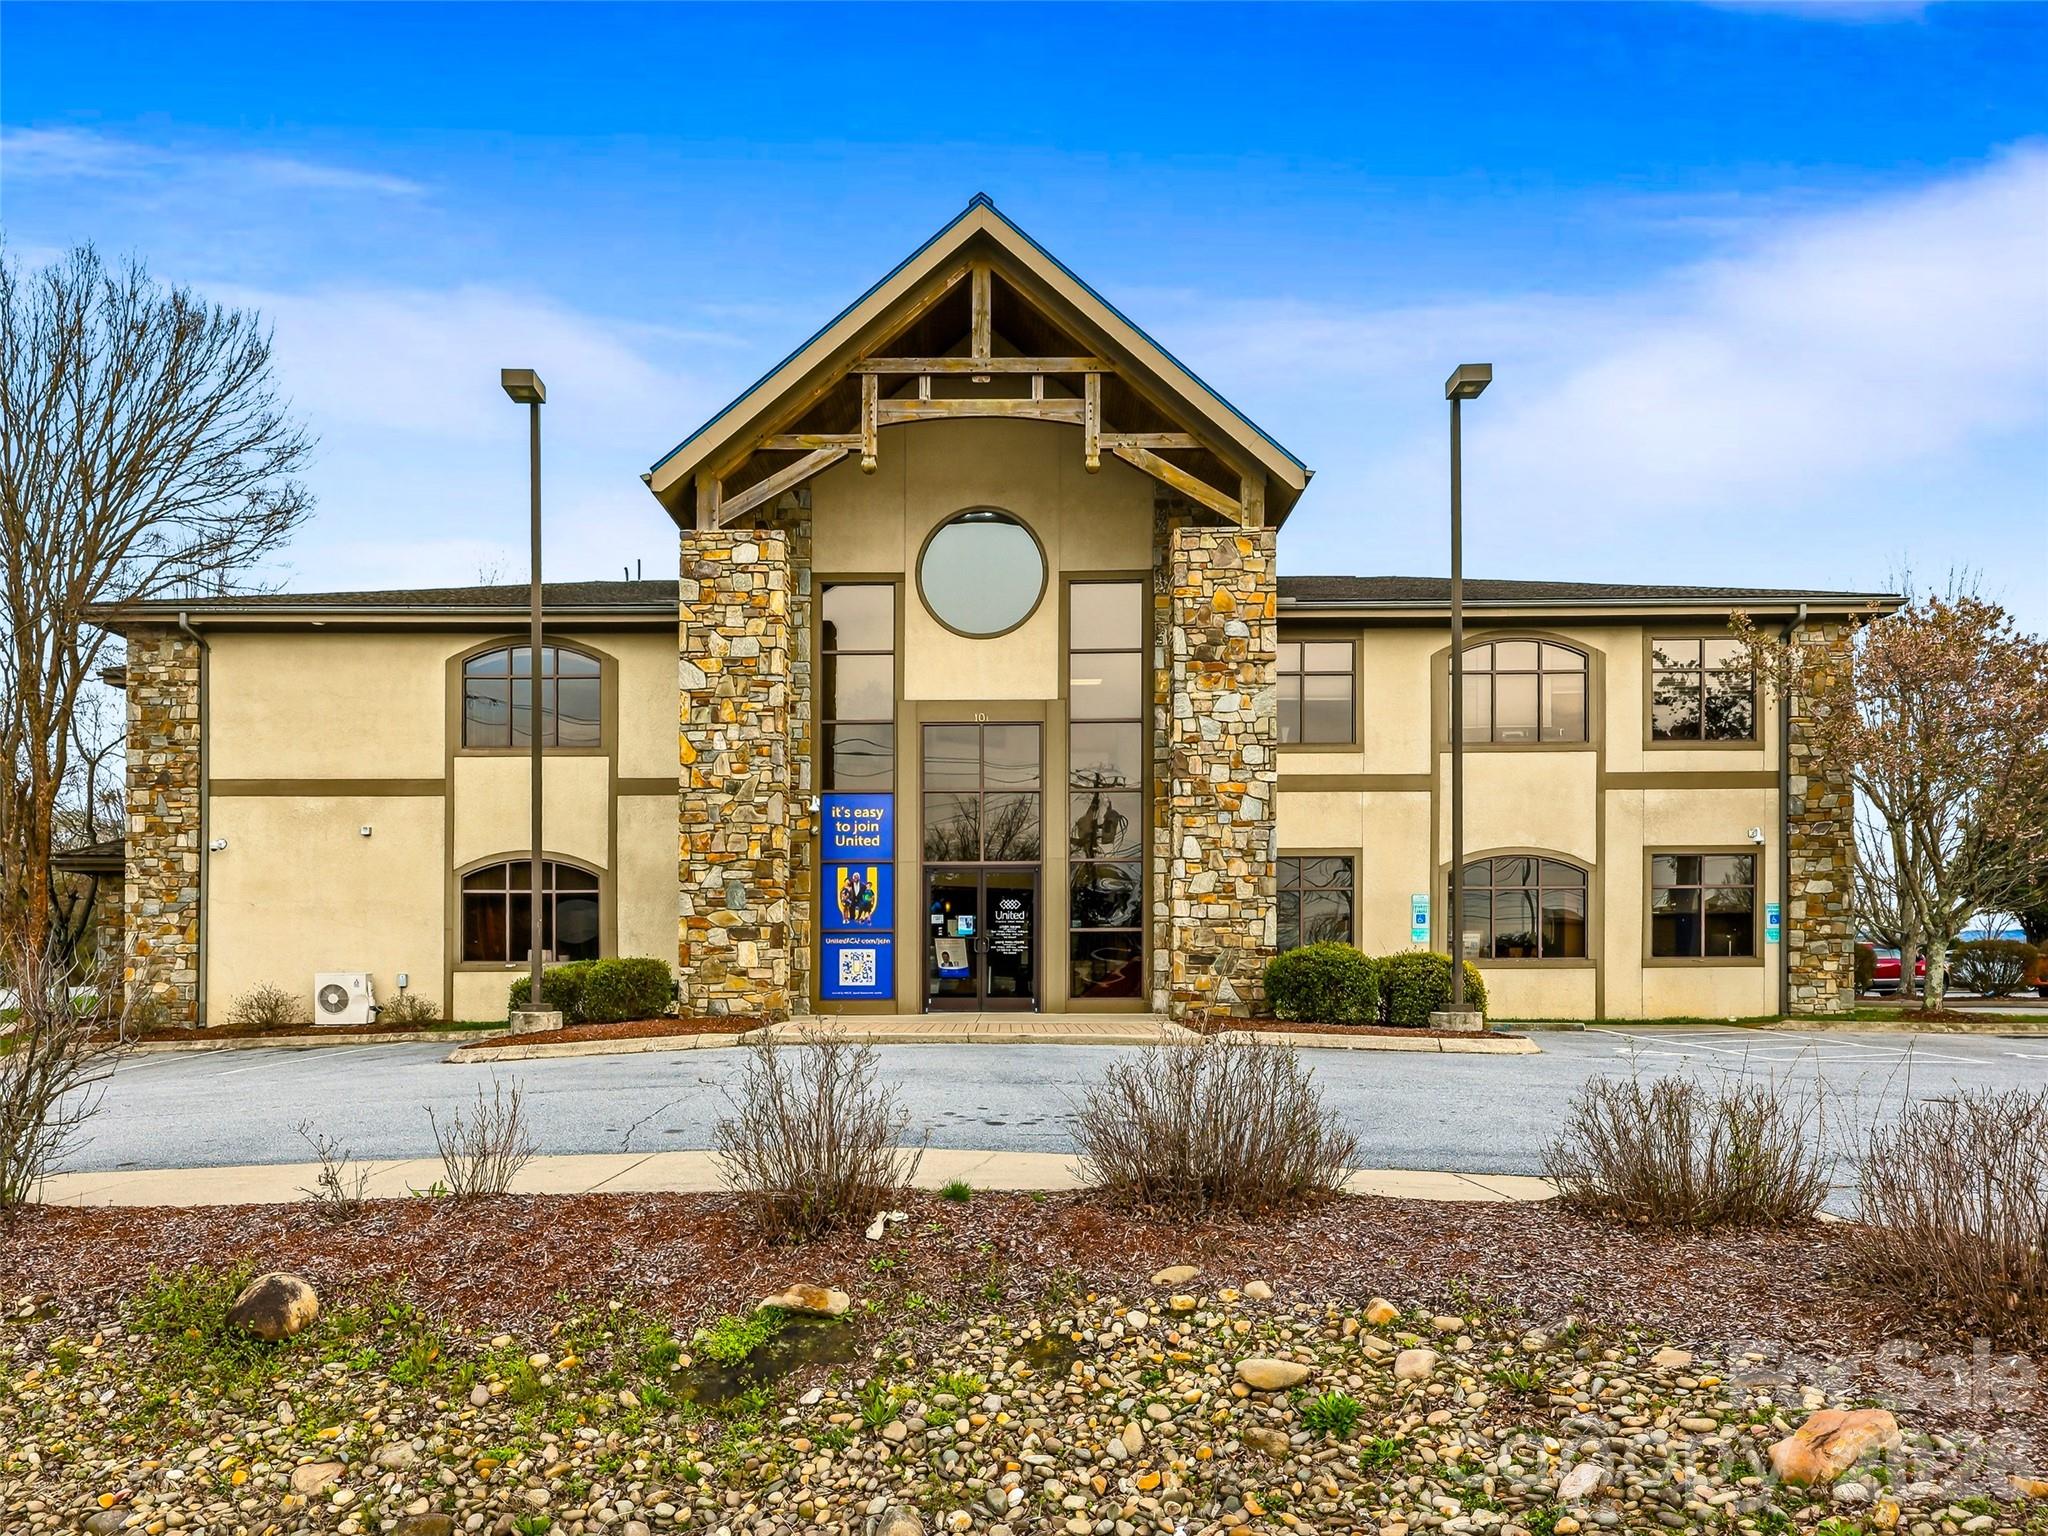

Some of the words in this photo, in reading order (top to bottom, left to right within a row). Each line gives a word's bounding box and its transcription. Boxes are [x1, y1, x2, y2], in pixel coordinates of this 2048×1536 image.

[832, 806, 851, 818] it's
[854, 808, 884, 820] easy
[836, 821, 851, 832] to
[852, 820, 879, 835] join
[835, 834, 880, 846] United
[995, 910, 1025, 920] United
